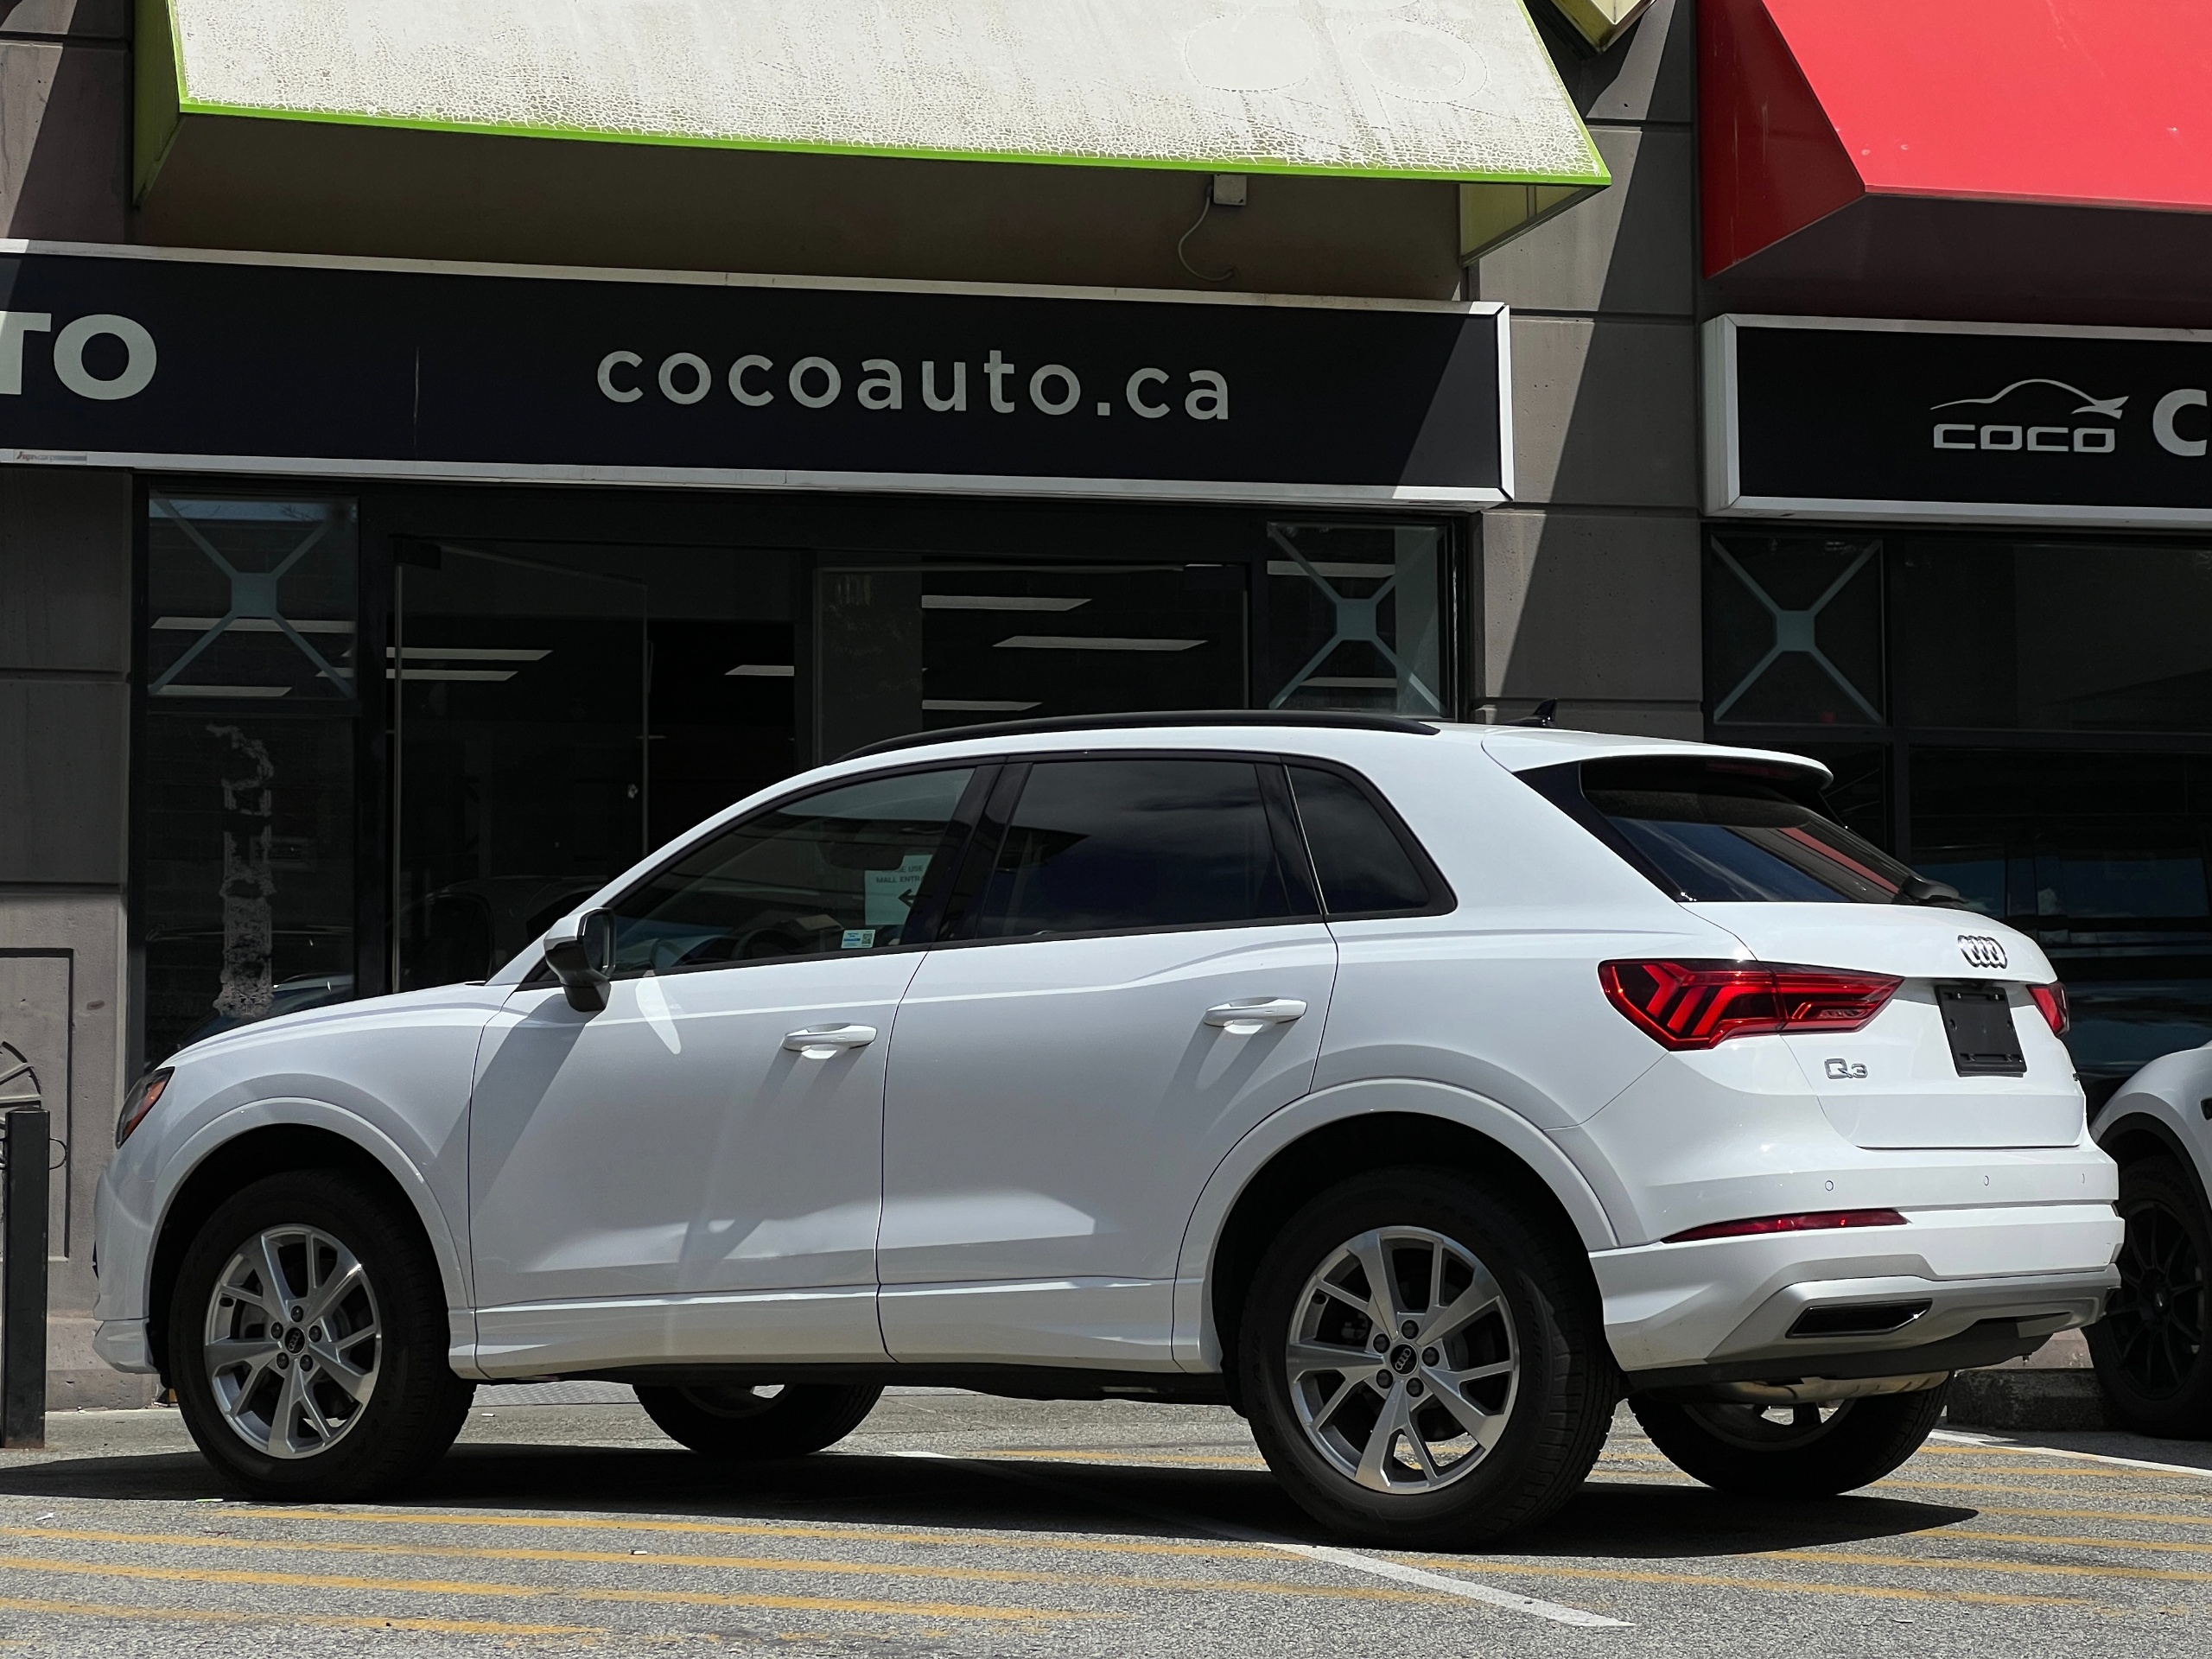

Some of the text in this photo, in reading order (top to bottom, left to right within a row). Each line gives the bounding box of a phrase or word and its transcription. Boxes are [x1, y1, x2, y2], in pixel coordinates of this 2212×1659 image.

[0, 310, 157, 401] TO
[596, 349, 1230, 421] cocoauto.ca
[1933, 423, 2116, 454] COCO
[1824, 1058, 1869, 1080] Q3
